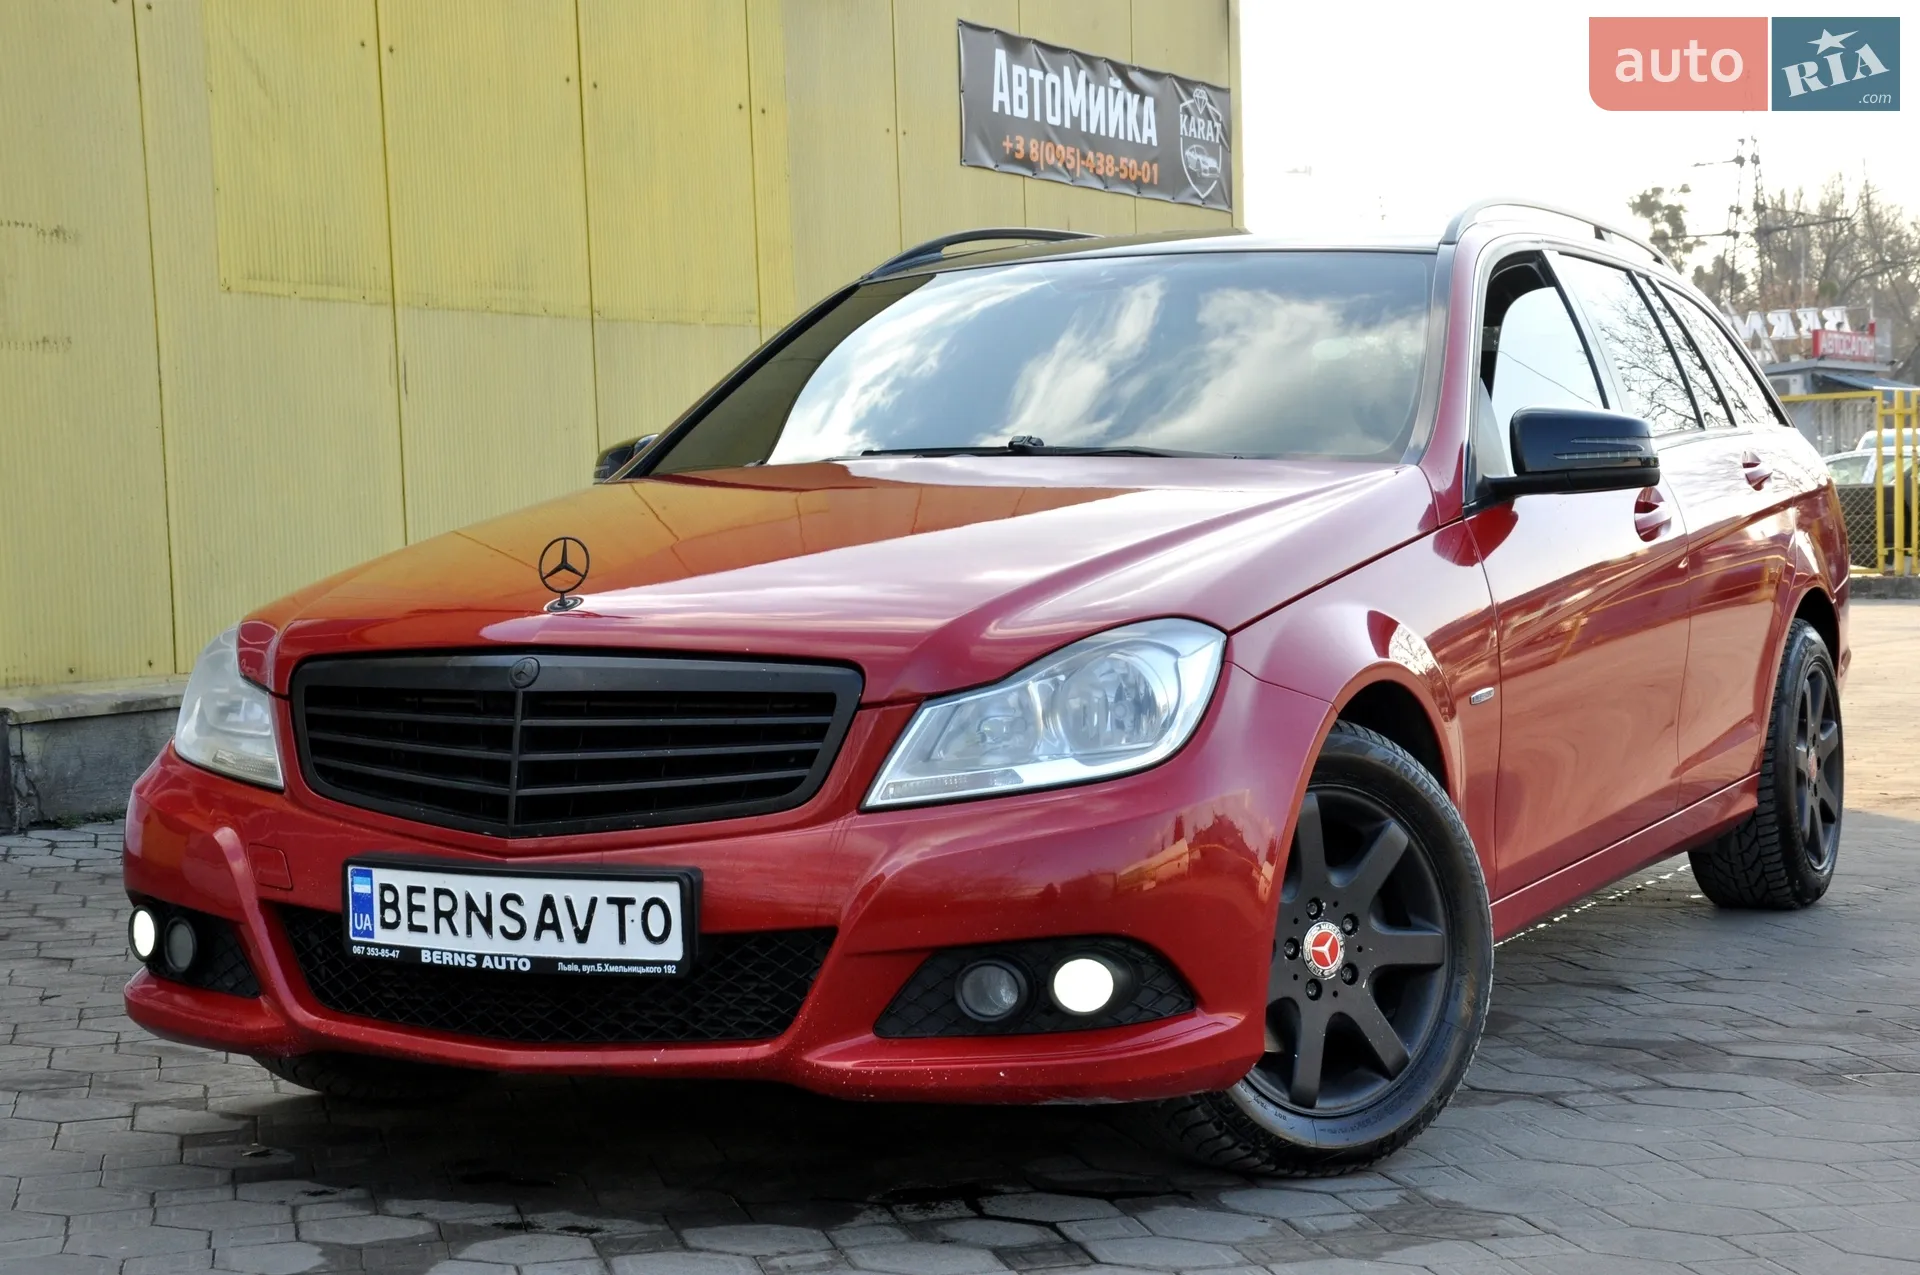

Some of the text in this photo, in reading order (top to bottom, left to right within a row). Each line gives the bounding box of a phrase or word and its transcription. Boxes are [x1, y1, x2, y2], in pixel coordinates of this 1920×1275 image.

[1179, 113, 1222, 144] KARAT
[1002, 135, 1159, 185] +3 8(095)-438-50-01
[354, 882, 673, 945] UA BERNSAVTO
[352, 945, 400, 960] 067 353-85-47
[421, 949, 531, 972] BERNS AUTO
[663, 964, 677, 975] 192
